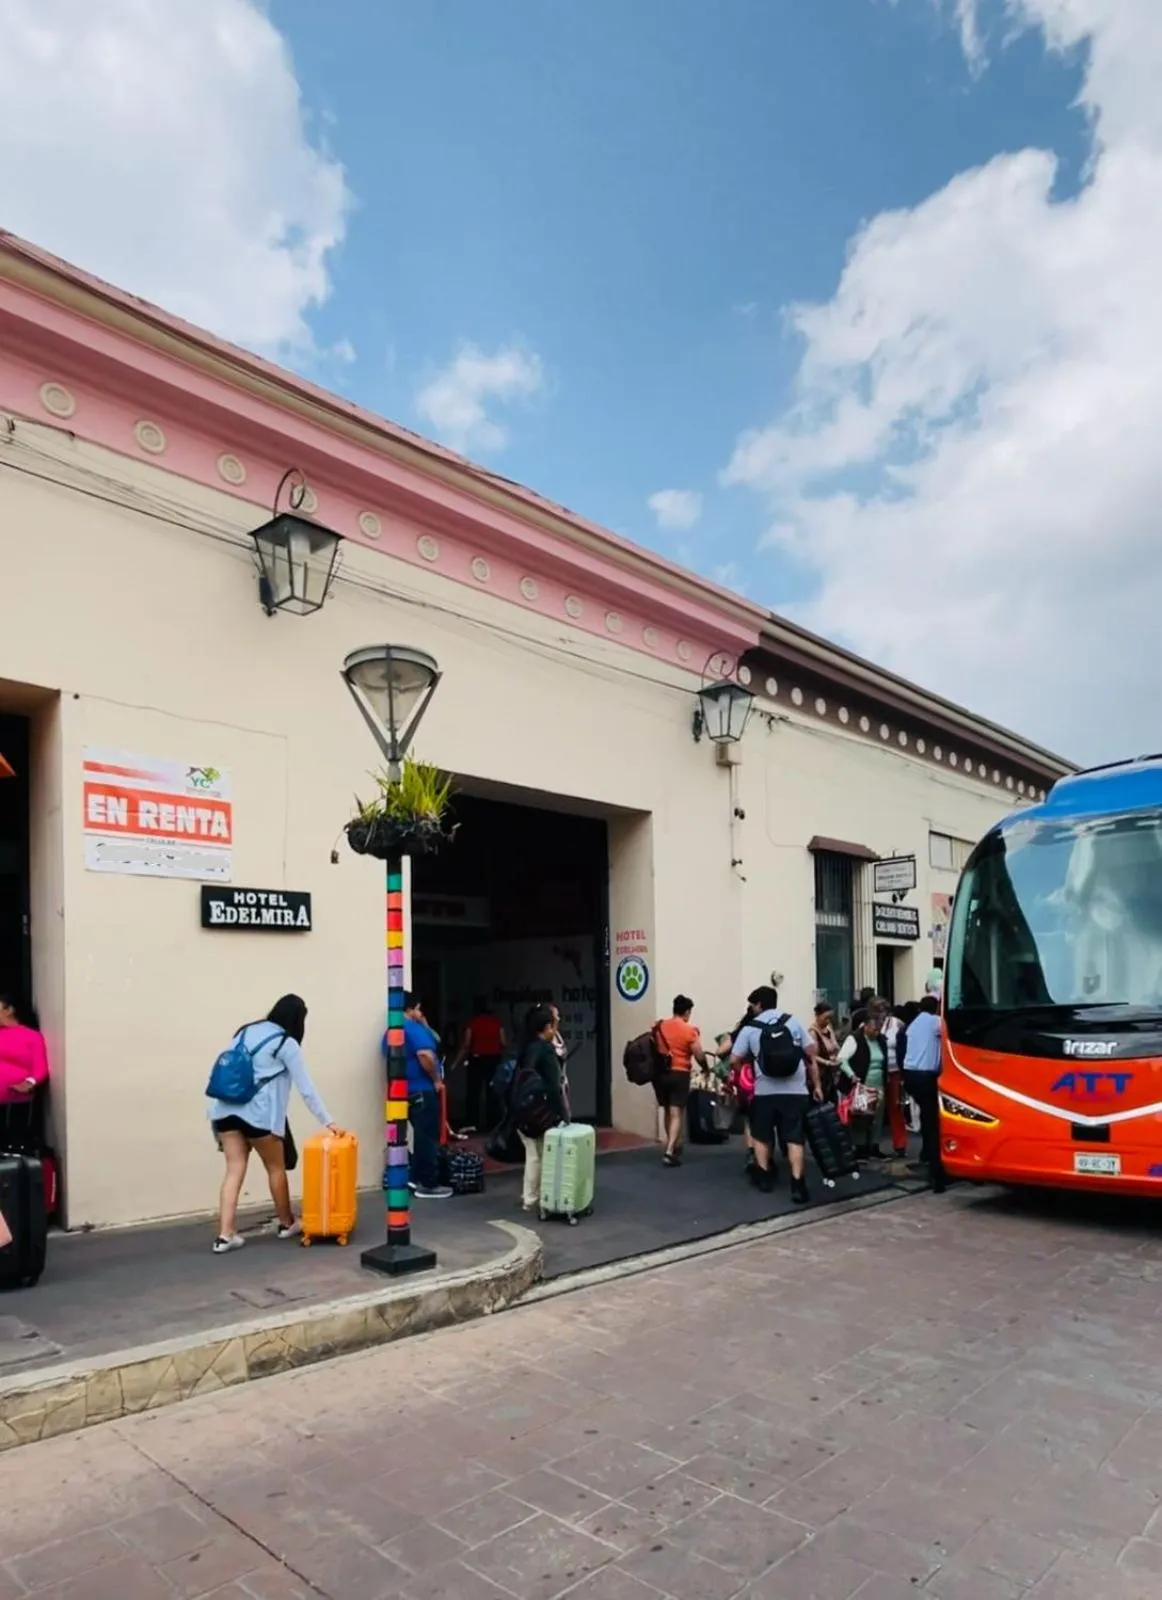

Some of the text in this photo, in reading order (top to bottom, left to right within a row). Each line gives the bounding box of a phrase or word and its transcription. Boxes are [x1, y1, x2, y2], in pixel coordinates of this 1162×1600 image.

[87, 794, 229, 838] EN RENTA
[233, 892, 288, 906] HOTEL
[209, 901, 310, 926] EDELMIRA
[615, 928, 647, 941] HOTEL
[1051, 1072, 1135, 1094] ATT
